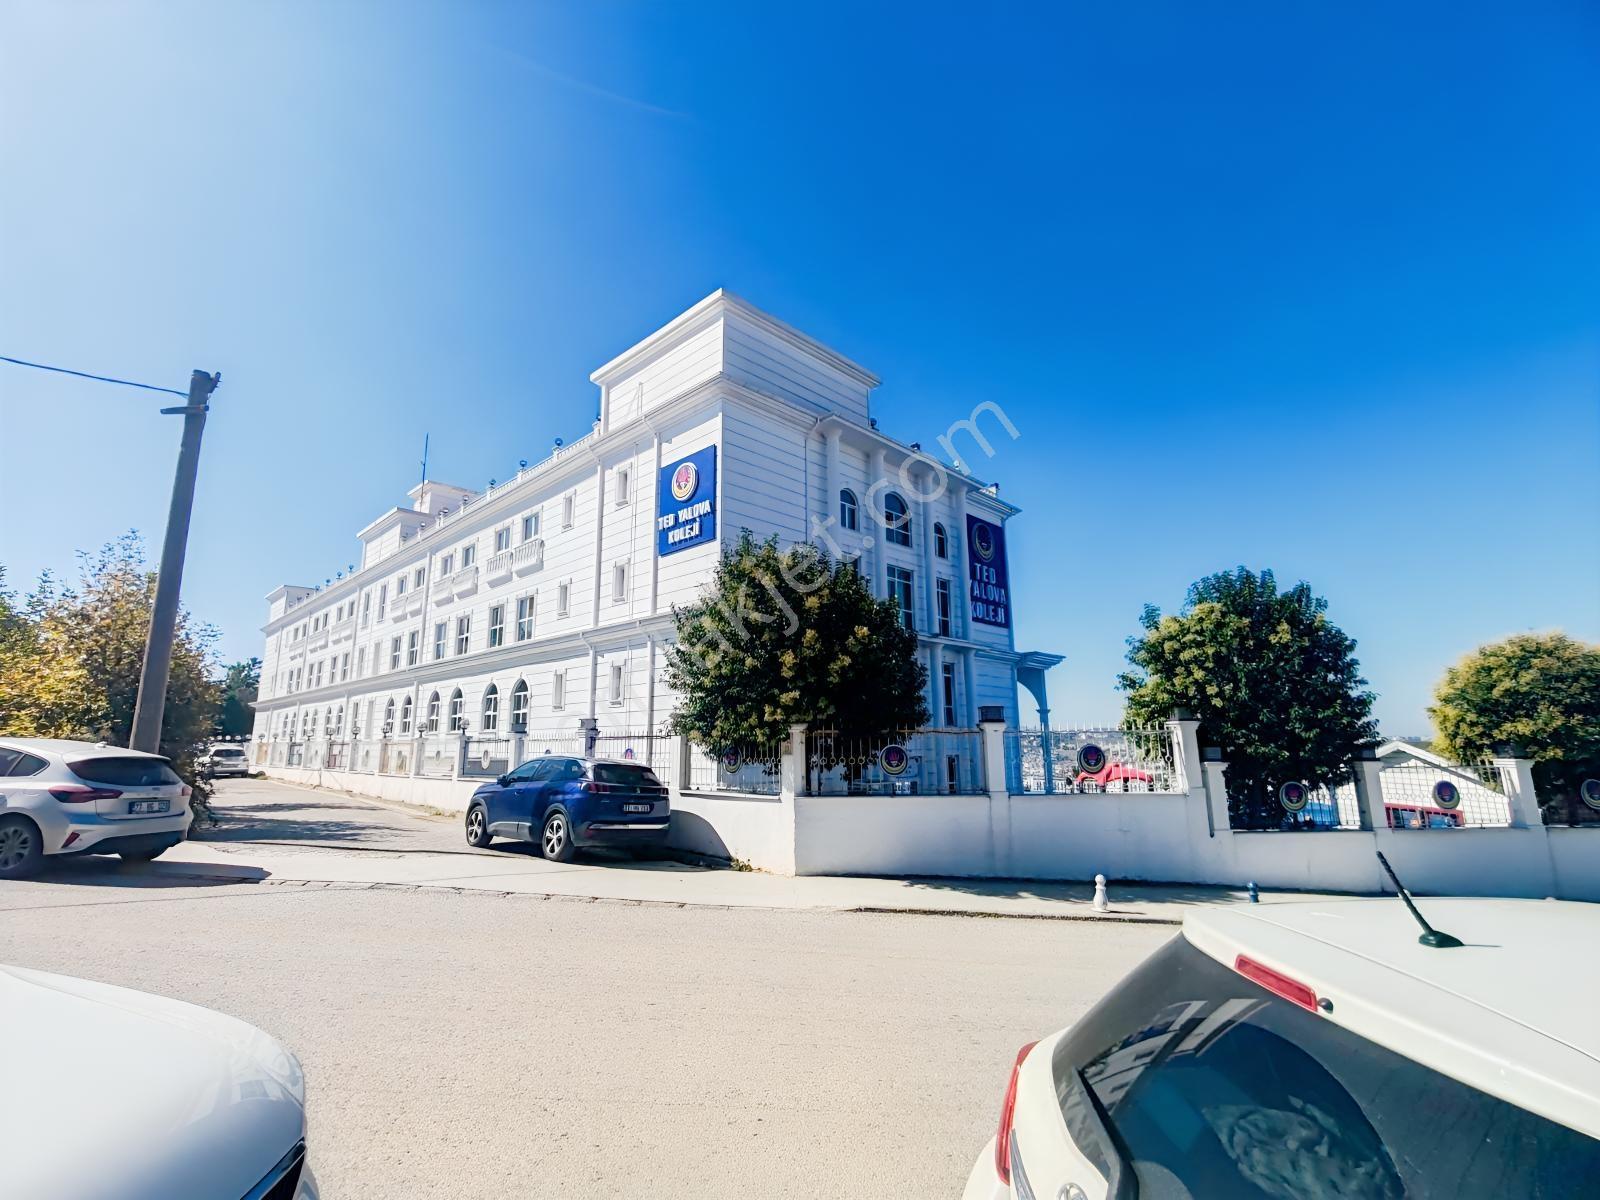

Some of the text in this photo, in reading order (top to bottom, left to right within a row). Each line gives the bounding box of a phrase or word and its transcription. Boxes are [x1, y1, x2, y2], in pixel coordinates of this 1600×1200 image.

[658, 500, 711, 530] TED YALOVA
[974, 562, 997, 584] TED
